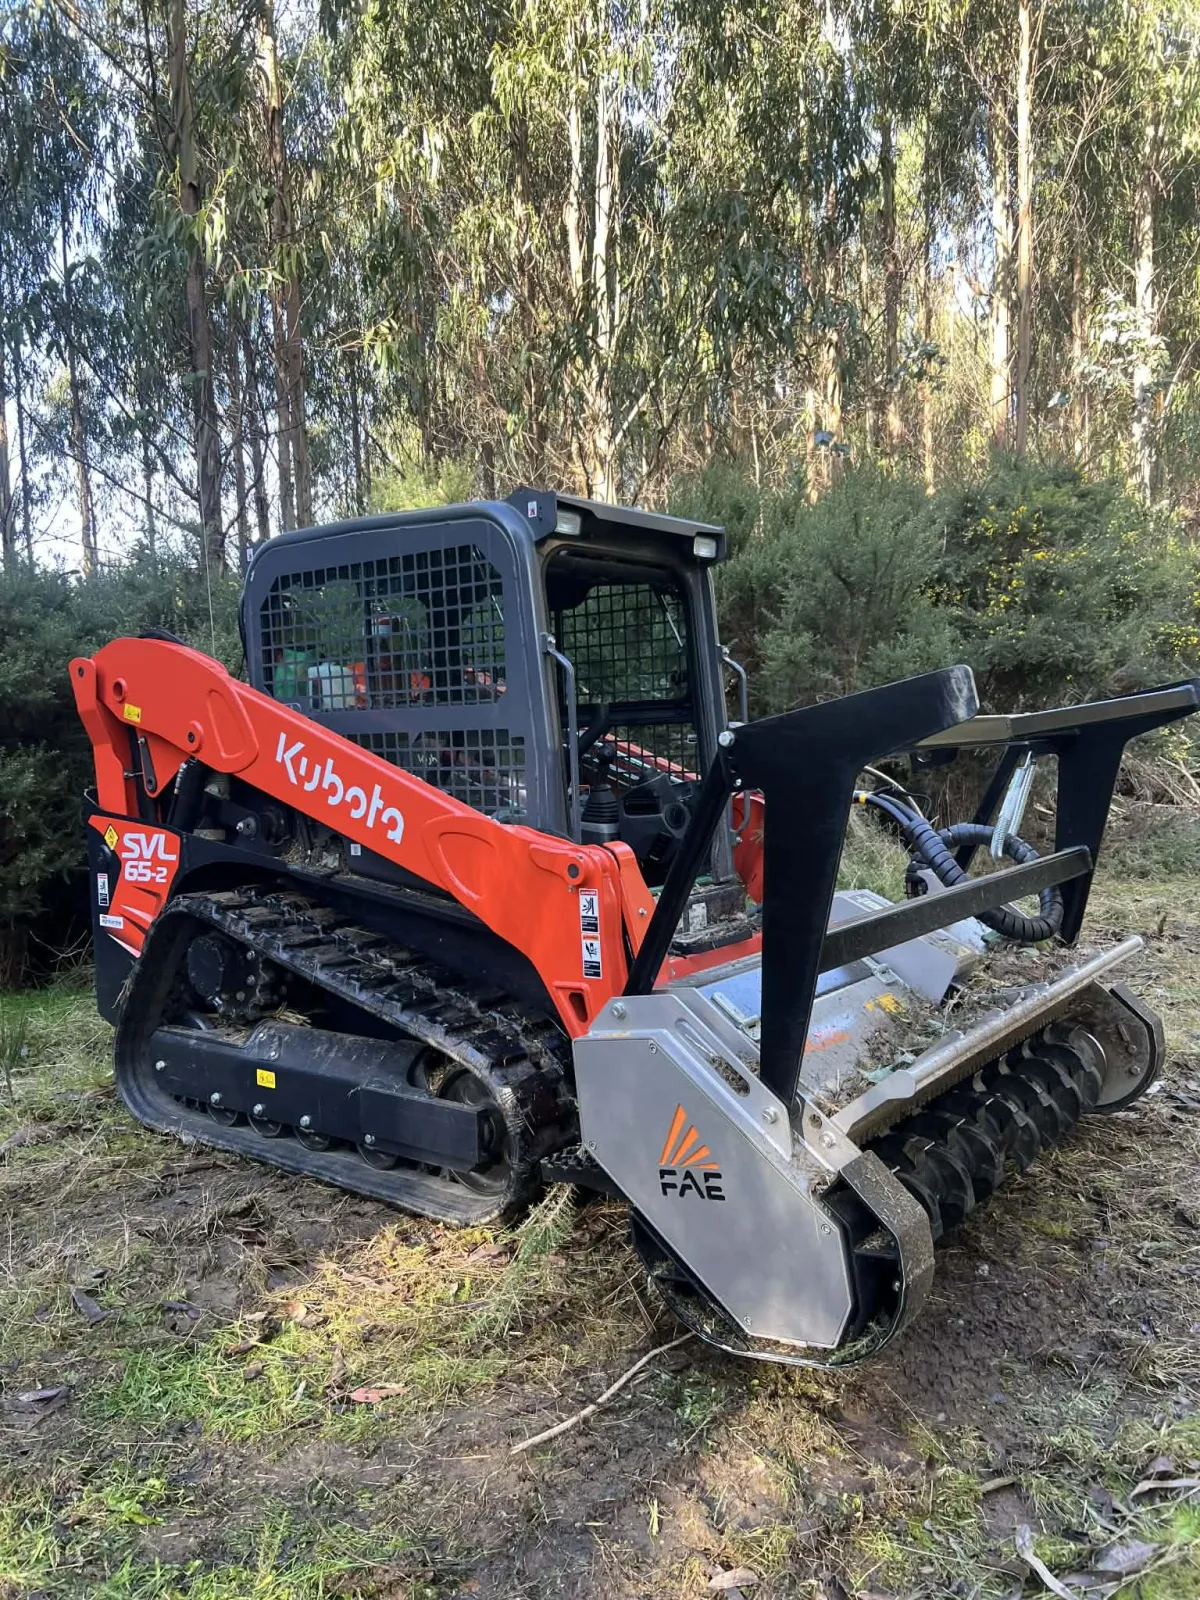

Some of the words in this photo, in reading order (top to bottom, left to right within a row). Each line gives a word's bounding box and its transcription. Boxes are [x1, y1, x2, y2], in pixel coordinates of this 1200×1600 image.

[275, 732, 405, 845] Kubota
[121, 832, 177, 861] SVL
[124, 860, 167, 883] 65-2
[659, 1169, 725, 1201] FAE
